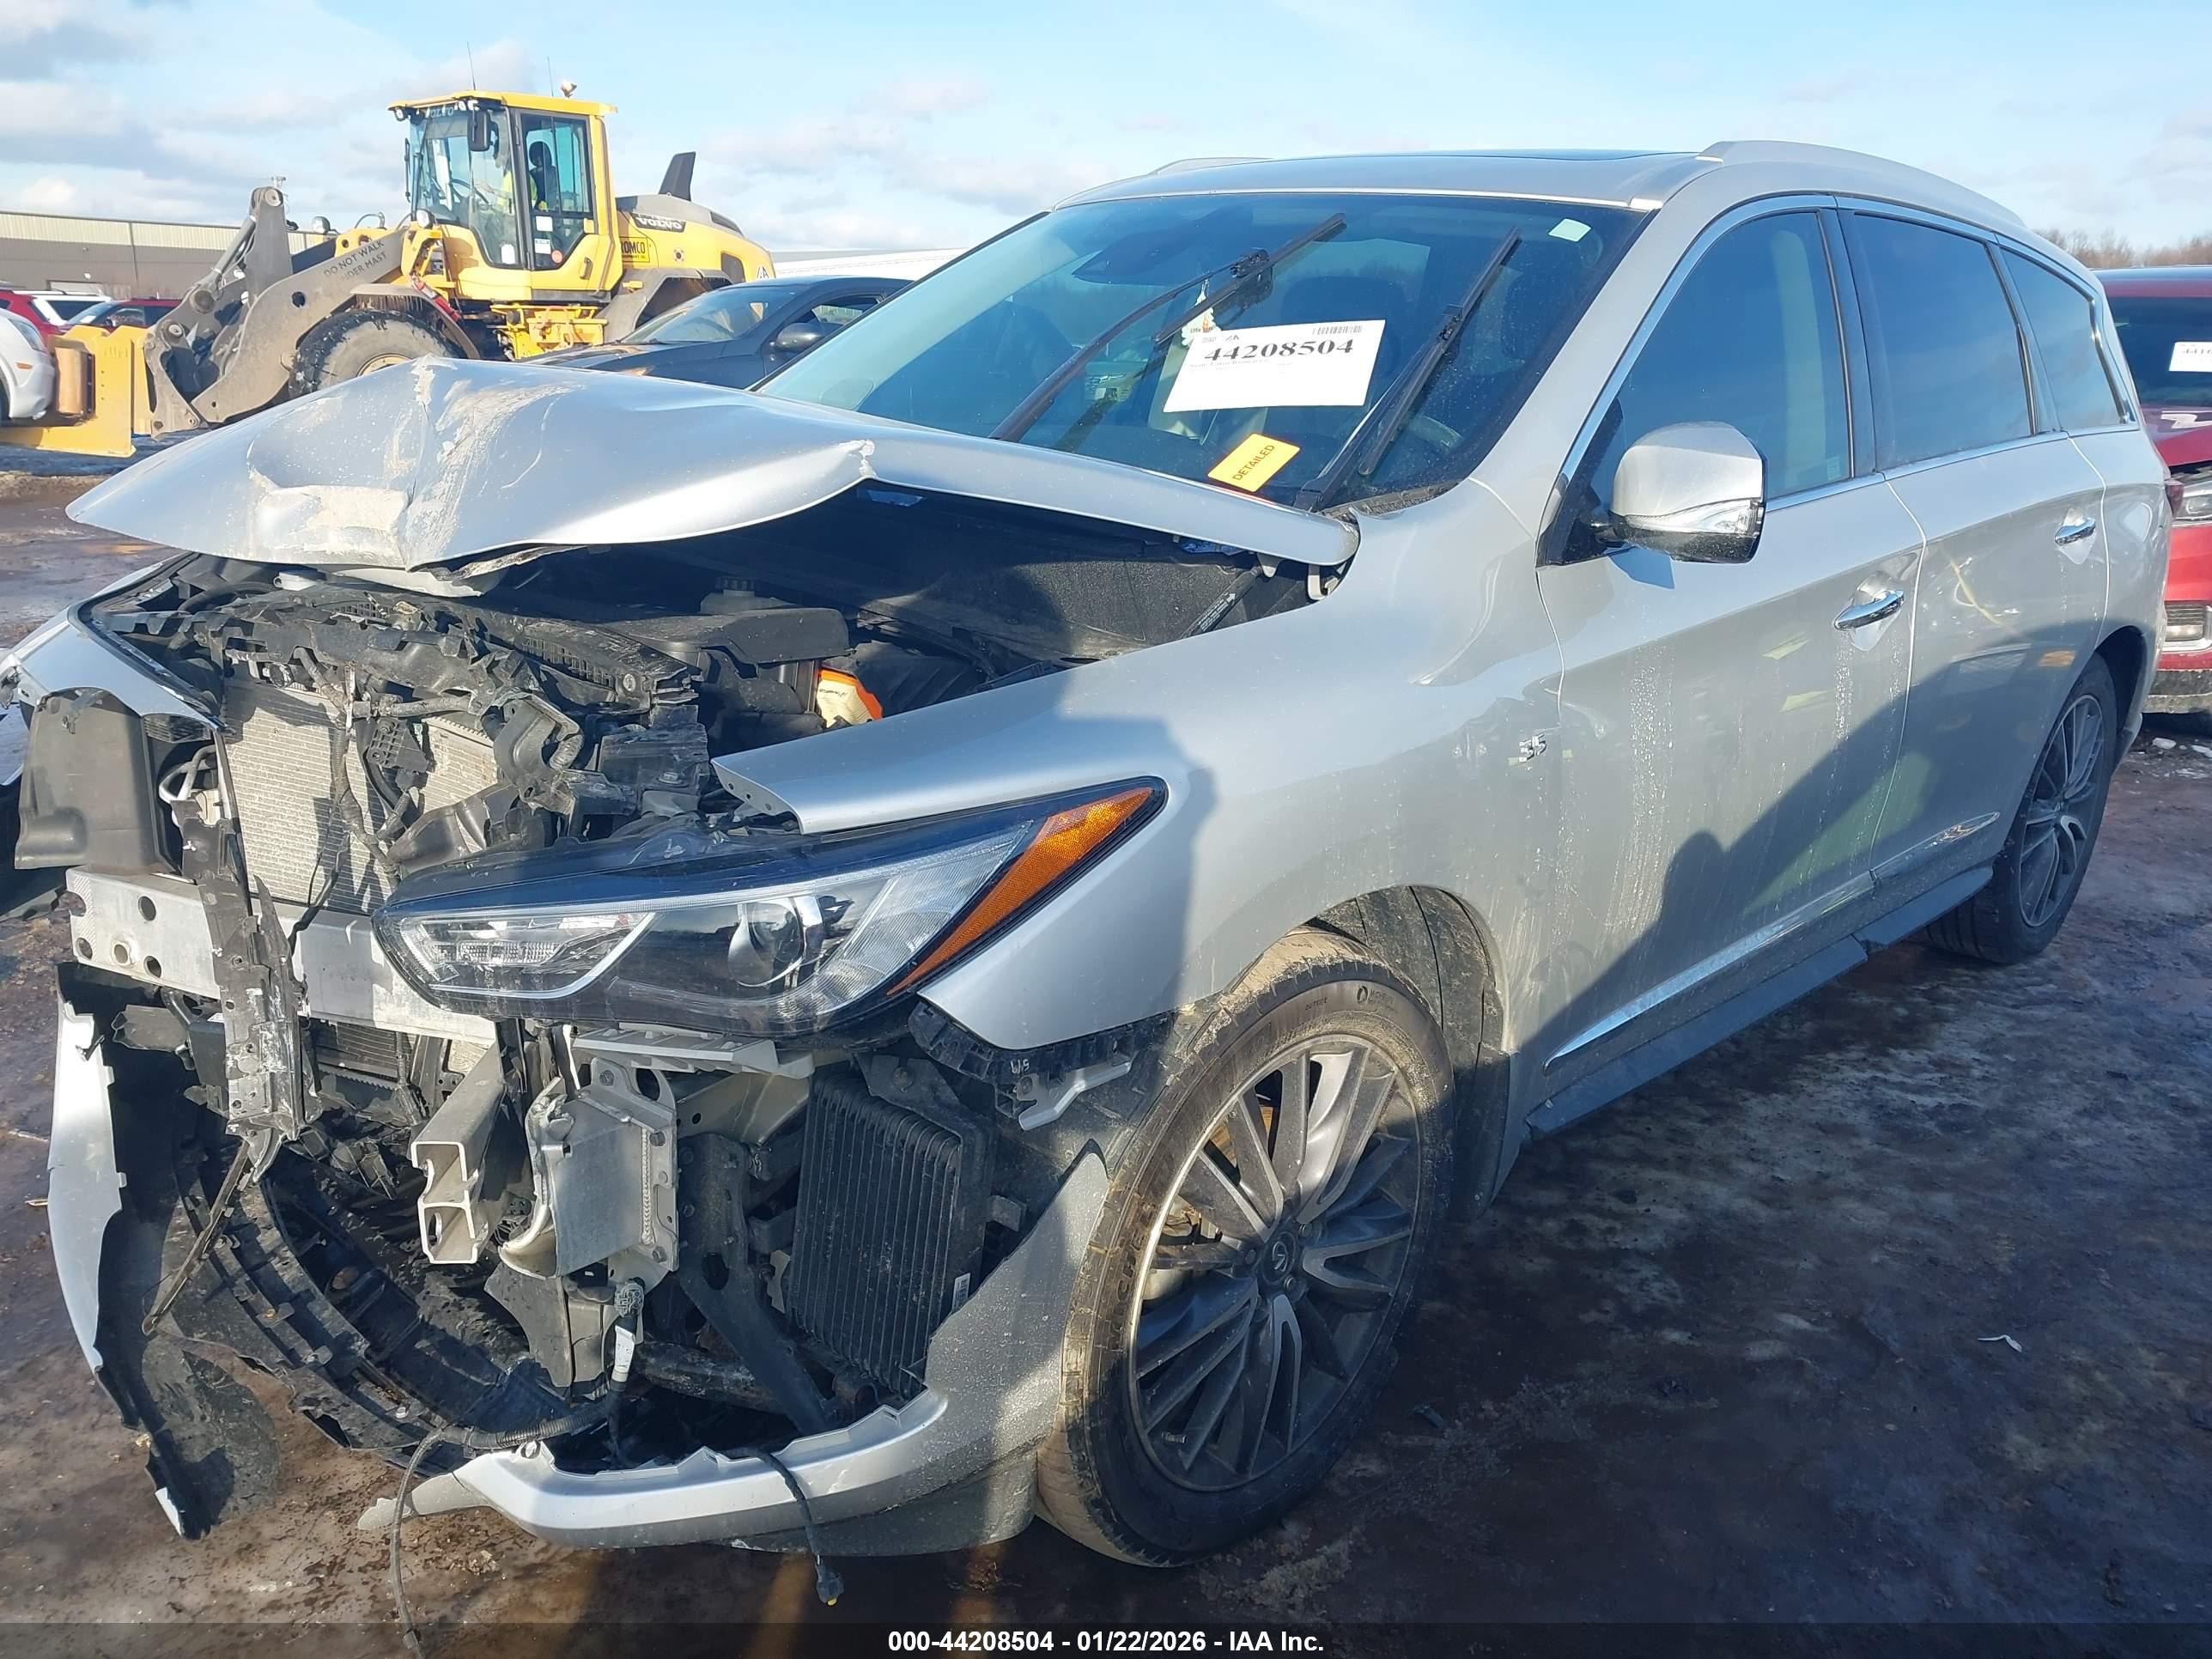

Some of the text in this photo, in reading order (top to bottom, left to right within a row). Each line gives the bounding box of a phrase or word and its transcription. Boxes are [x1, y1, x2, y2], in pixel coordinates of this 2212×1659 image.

[635, 216, 683, 229] VOLVO
[323, 240, 385, 277] DO NOT WALK
[364, 252, 387, 269] MAST
[1204, 338, 1354, 362] 44208504
[1232, 445, 1275, 481] DETAILED
